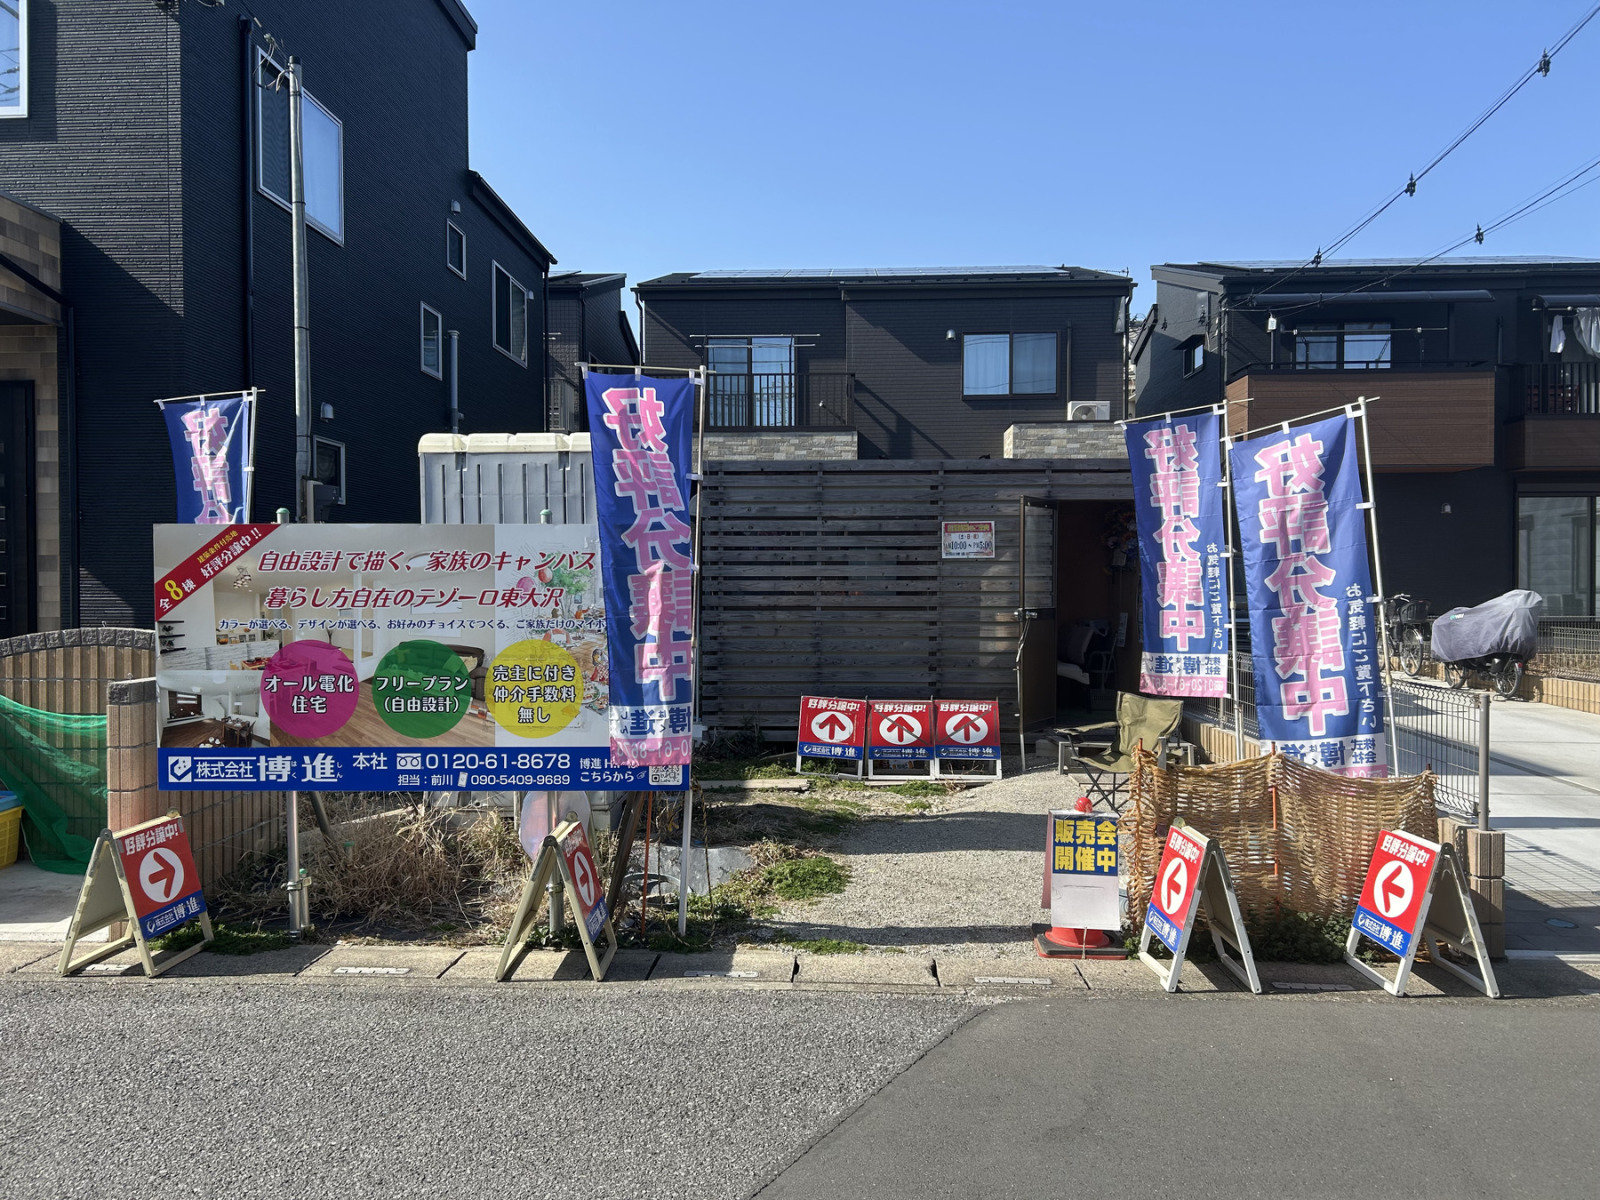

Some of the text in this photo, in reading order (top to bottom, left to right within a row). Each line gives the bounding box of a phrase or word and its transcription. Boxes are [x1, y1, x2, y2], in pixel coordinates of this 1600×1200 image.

[258, 550, 596, 572] 自由設計で描く、家族のキャンバス
[160, 579, 196, 611] 全8棟
[265, 588, 564, 608] 暮らし方自在のテゾーロ東大沢
[494, 665, 576, 681] 売主に付き
[264, 675, 354, 693] オール電化
[376, 676, 468, 691] フリープラン
[494, 686, 576, 702] 仲介手数料
[291, 695, 327, 713] 住宅
[518, 707, 550, 723] 無し
[196, 752, 570, 782] 株式会社 博進 本社 0120-61-8678
[579, 758, 602, 769] 博進
[471, 775, 570, 785] 090-5409-9689
[580, 771, 634, 782] こちらから
[1055, 819, 1117, 846] 販売会
[1055, 846, 1116, 872] 開催中
